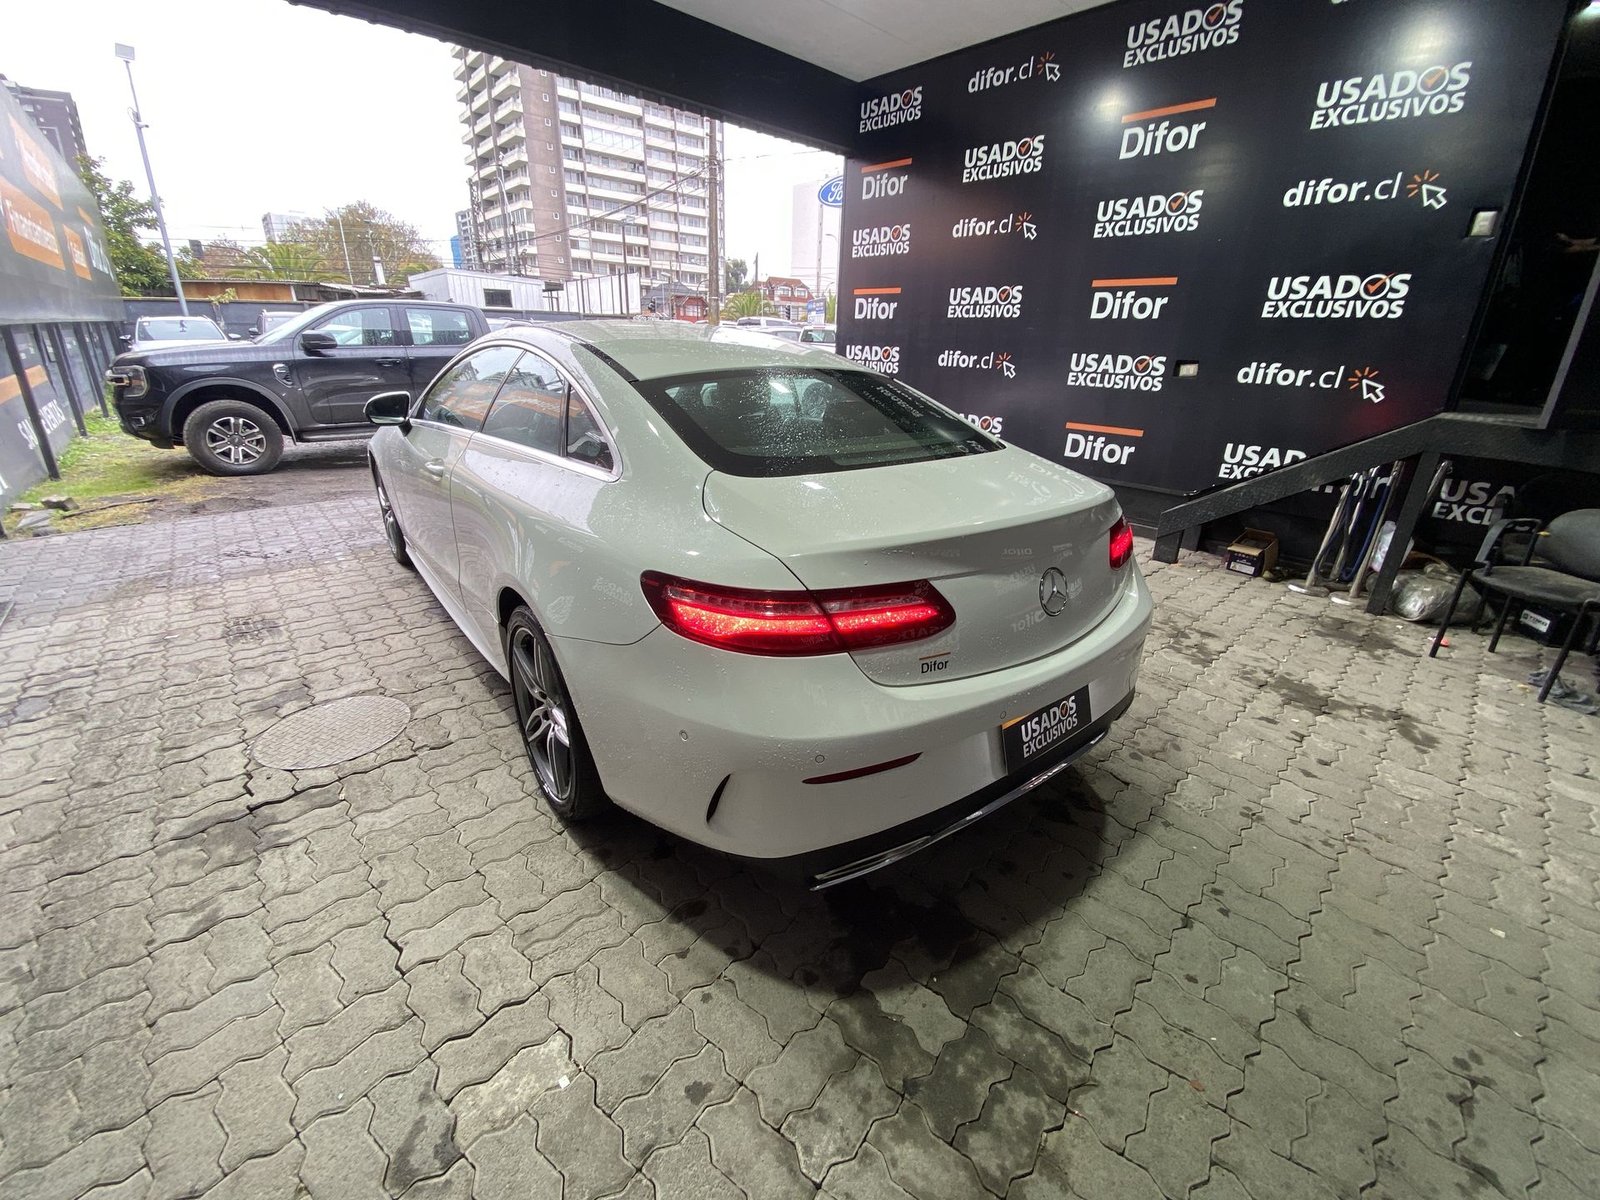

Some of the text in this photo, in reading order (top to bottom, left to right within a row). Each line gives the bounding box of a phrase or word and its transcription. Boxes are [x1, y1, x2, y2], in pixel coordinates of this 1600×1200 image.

[1126, 0, 1243, 48] USADOS
[1123, 24, 1240, 69] EXCLUSIVOS
[968, 56, 1033, 94] difor.cl
[1315, 61, 1473, 108] USADOS
[860, 86, 923, 119] USADOS
[1310, 91, 1466, 130] EXCLUSIVOS
[859, 105, 922, 134] EXCLUSIVOS
[965, 135, 1045, 168] USADOS
[1119, 120, 1206, 160] Difor
[962, 156, 1042, 184] EXCLUSIVOS
[828, 182, 843, 202] Fo
[861, 172, 908, 200] Difor
[1283, 171, 1403, 208] difor.cl
[1097, 189, 1204, 223] USADOS
[852, 223, 911, 245] USADOS
[952, 213, 1013, 239] difor.cl
[1093, 213, 1199, 240] EXCLUSIVOS
[852, 243, 910, 258] EXCLUSIVOS
[949, 285, 1023, 306] USADOS
[1266, 273, 1413, 301] USADOS
[854, 297, 897, 320] Difor
[947, 304, 1021, 319] EXCLUSIVOS
[1090, 290, 1168, 320] Difor
[1261, 300, 1406, 319] EXCLUSIVOS
[846, 345, 900, 362] USADOS
[938, 350, 994, 370] difor.cl
[1069, 353, 1167, 377] USADOS
[1067, 371, 1163, 392] EXCLUSIVOS
[1237, 361, 1345, 390] difor.cl
[958, 411, 1003, 434] DOS
[1064, 433, 1136, 466] Difor
[1224, 443, 1306, 468] USAD
[921, 659, 948, 675] Difor
[1021, 695, 1077, 742] USADOS
[1023, 713, 1077, 757] EXCLUSIVOS
